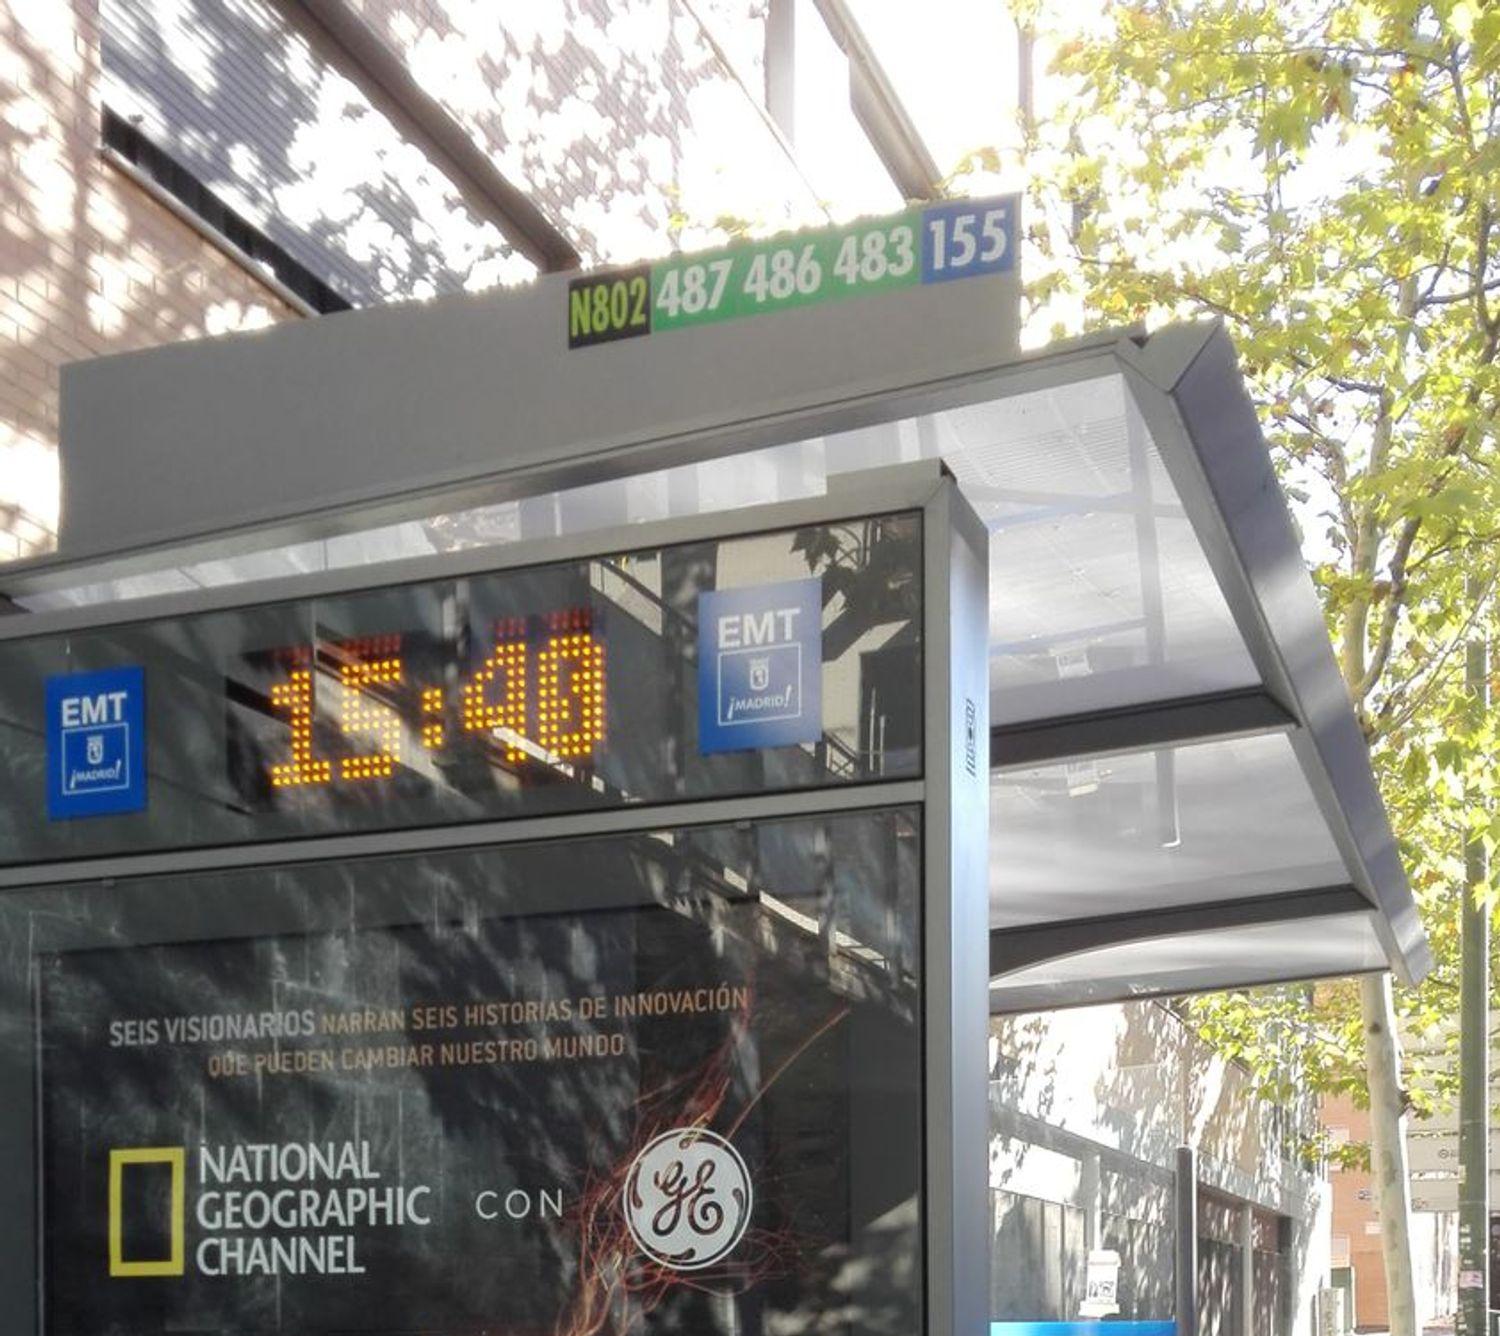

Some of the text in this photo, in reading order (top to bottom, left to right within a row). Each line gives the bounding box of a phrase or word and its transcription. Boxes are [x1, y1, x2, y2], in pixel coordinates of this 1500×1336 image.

[570, 210, 1008, 337] N802 487 486 483 155
[718, 607, 800, 648] EMT
[62, 692, 128, 728] EMT
[271, 633, 606, 788] 15:40
[727, 685, 793, 720] ¡MADRID!
[109, 980, 748, 1047] SEIS VISIONARIOS NARRAN SEIS HISTORIAS DE INNOVACIÓN
[208, 1033, 624, 1078] QUE PUEDEN CAMBIAR NUESTRO MUNDO
[200, 1140, 380, 1183] NATIONAL
[196, 1185, 432, 1230] GEOGRAPHIC
[475, 1188, 563, 1220] CON
[196, 1235, 366, 1276] CHANNEL
